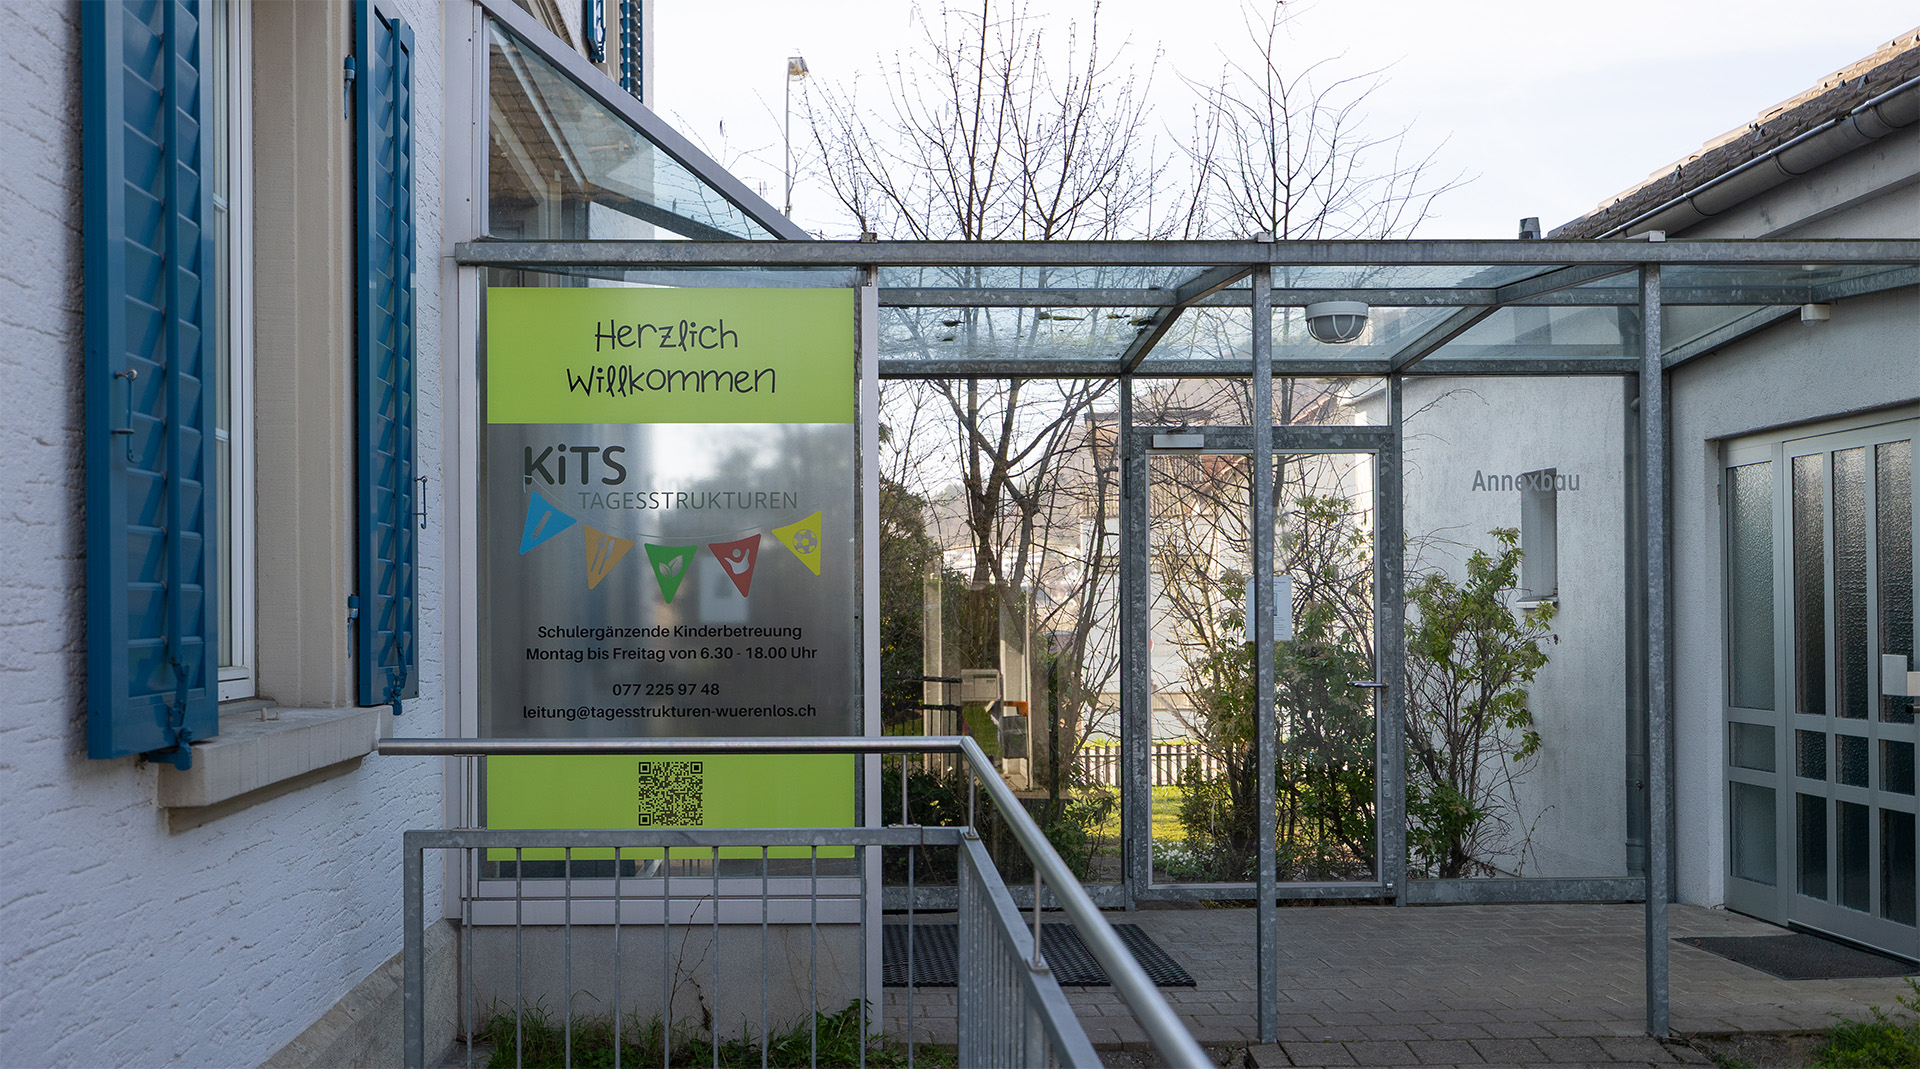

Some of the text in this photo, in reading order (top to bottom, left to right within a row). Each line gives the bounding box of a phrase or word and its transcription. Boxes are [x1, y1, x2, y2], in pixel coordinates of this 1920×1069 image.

[595, 319, 739, 352] Herzlich
[566, 365, 776, 398] Willkommen
[524, 443, 627, 486] KiTS
[1472, 470, 1580, 492] Annexbau
[578, 491, 798, 510] TAGESSTRUKTUREN
[537, 624, 802, 641] Schulergänzende Kinderbetreuung
[526, 647, 584, 664] Montag
[587, 646, 610, 661] bis
[613, 647, 666, 664] Freitag
[668, 649, 697, 660] von
[700, 646, 734, 660] 6.30
[745, 646, 788, 660] 18.00
[790, 645, 818, 660] Uhr
[612, 682, 720, 697] 077 225 97 48
[522, 704, 817, 722] leitung@tagesstrukturen-wuerenlos.ch
